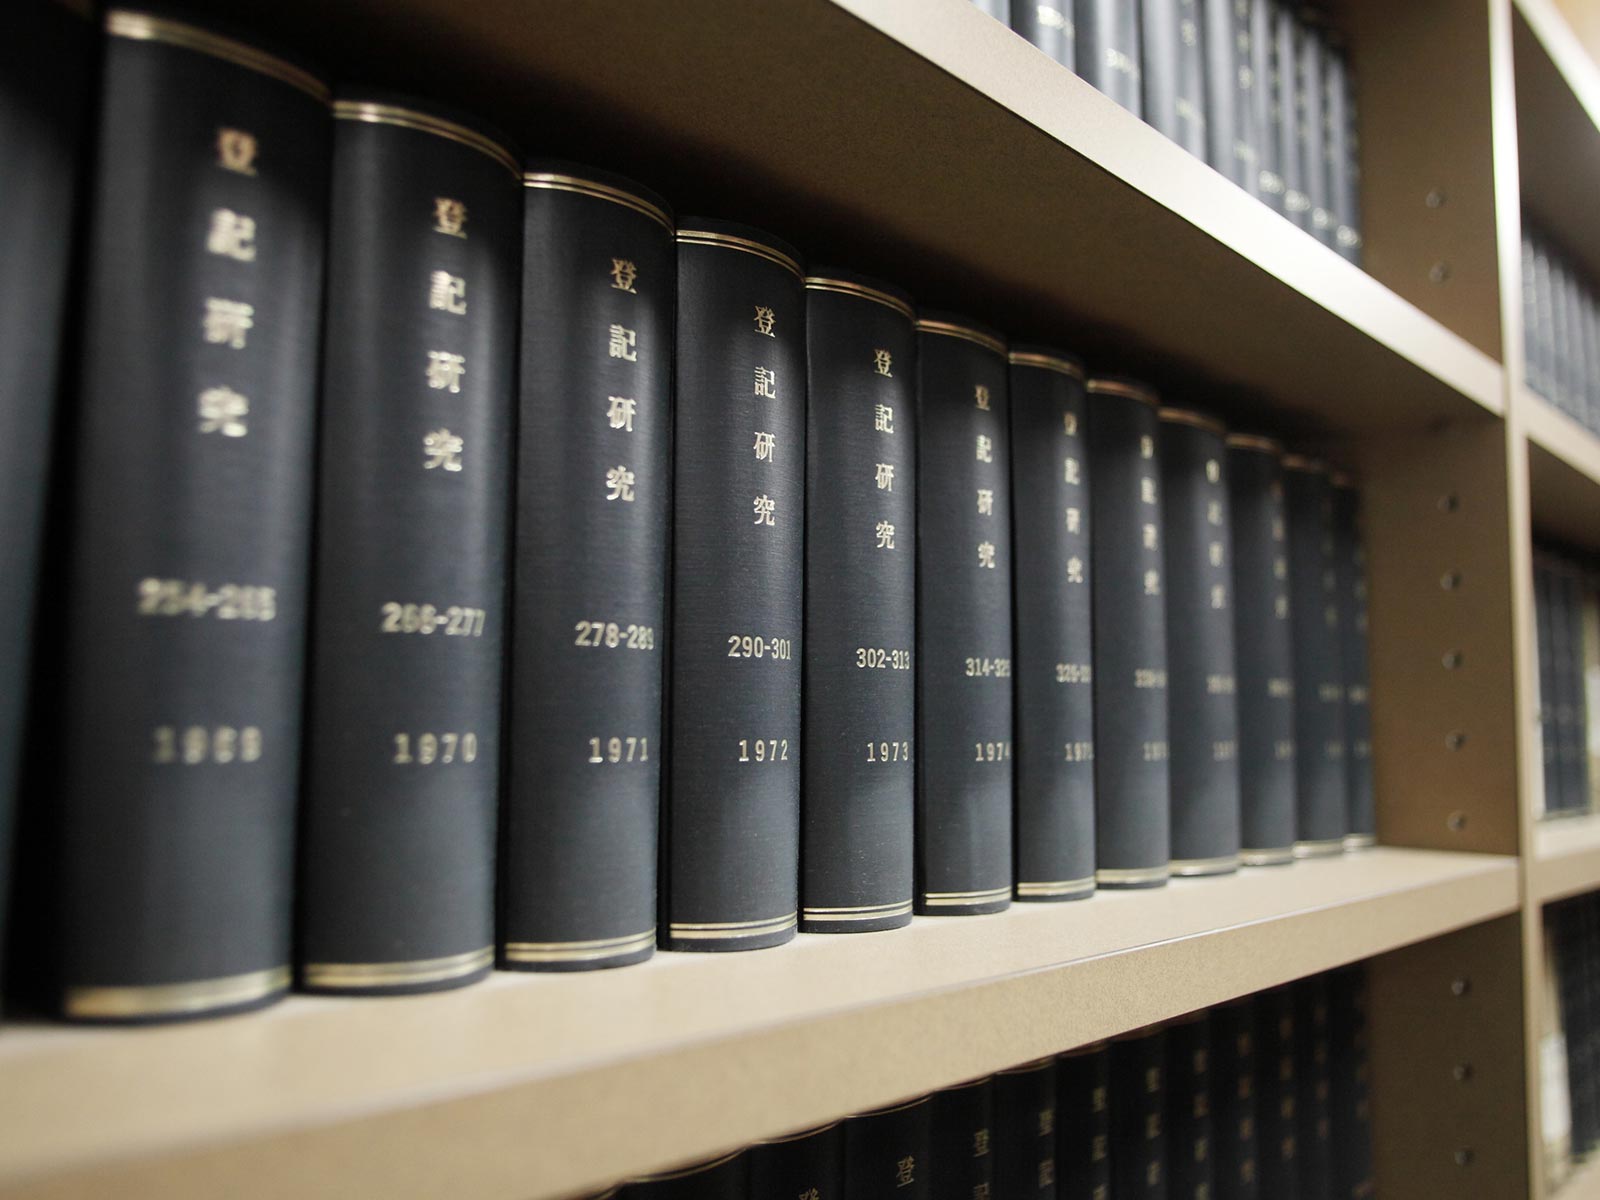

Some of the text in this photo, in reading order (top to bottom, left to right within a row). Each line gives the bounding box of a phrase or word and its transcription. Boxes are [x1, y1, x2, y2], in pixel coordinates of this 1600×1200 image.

[424, 197, 468, 472] 登記研究
[606, 257, 637, 502] 登記研究
[753, 305, 776, 526] 登記研究
[873, 348, 896, 549] 登記研究
[975, 385, 996, 569] 登記研究
[574, 620, 655, 650] 278-289
[727, 635, 792, 660] 290-301
[856, 648, 910, 670] 302-313
[588, 737, 649, 763] 1971
[738, 738, 789, 762] 1972
[866, 742, 909, 762] 1973
